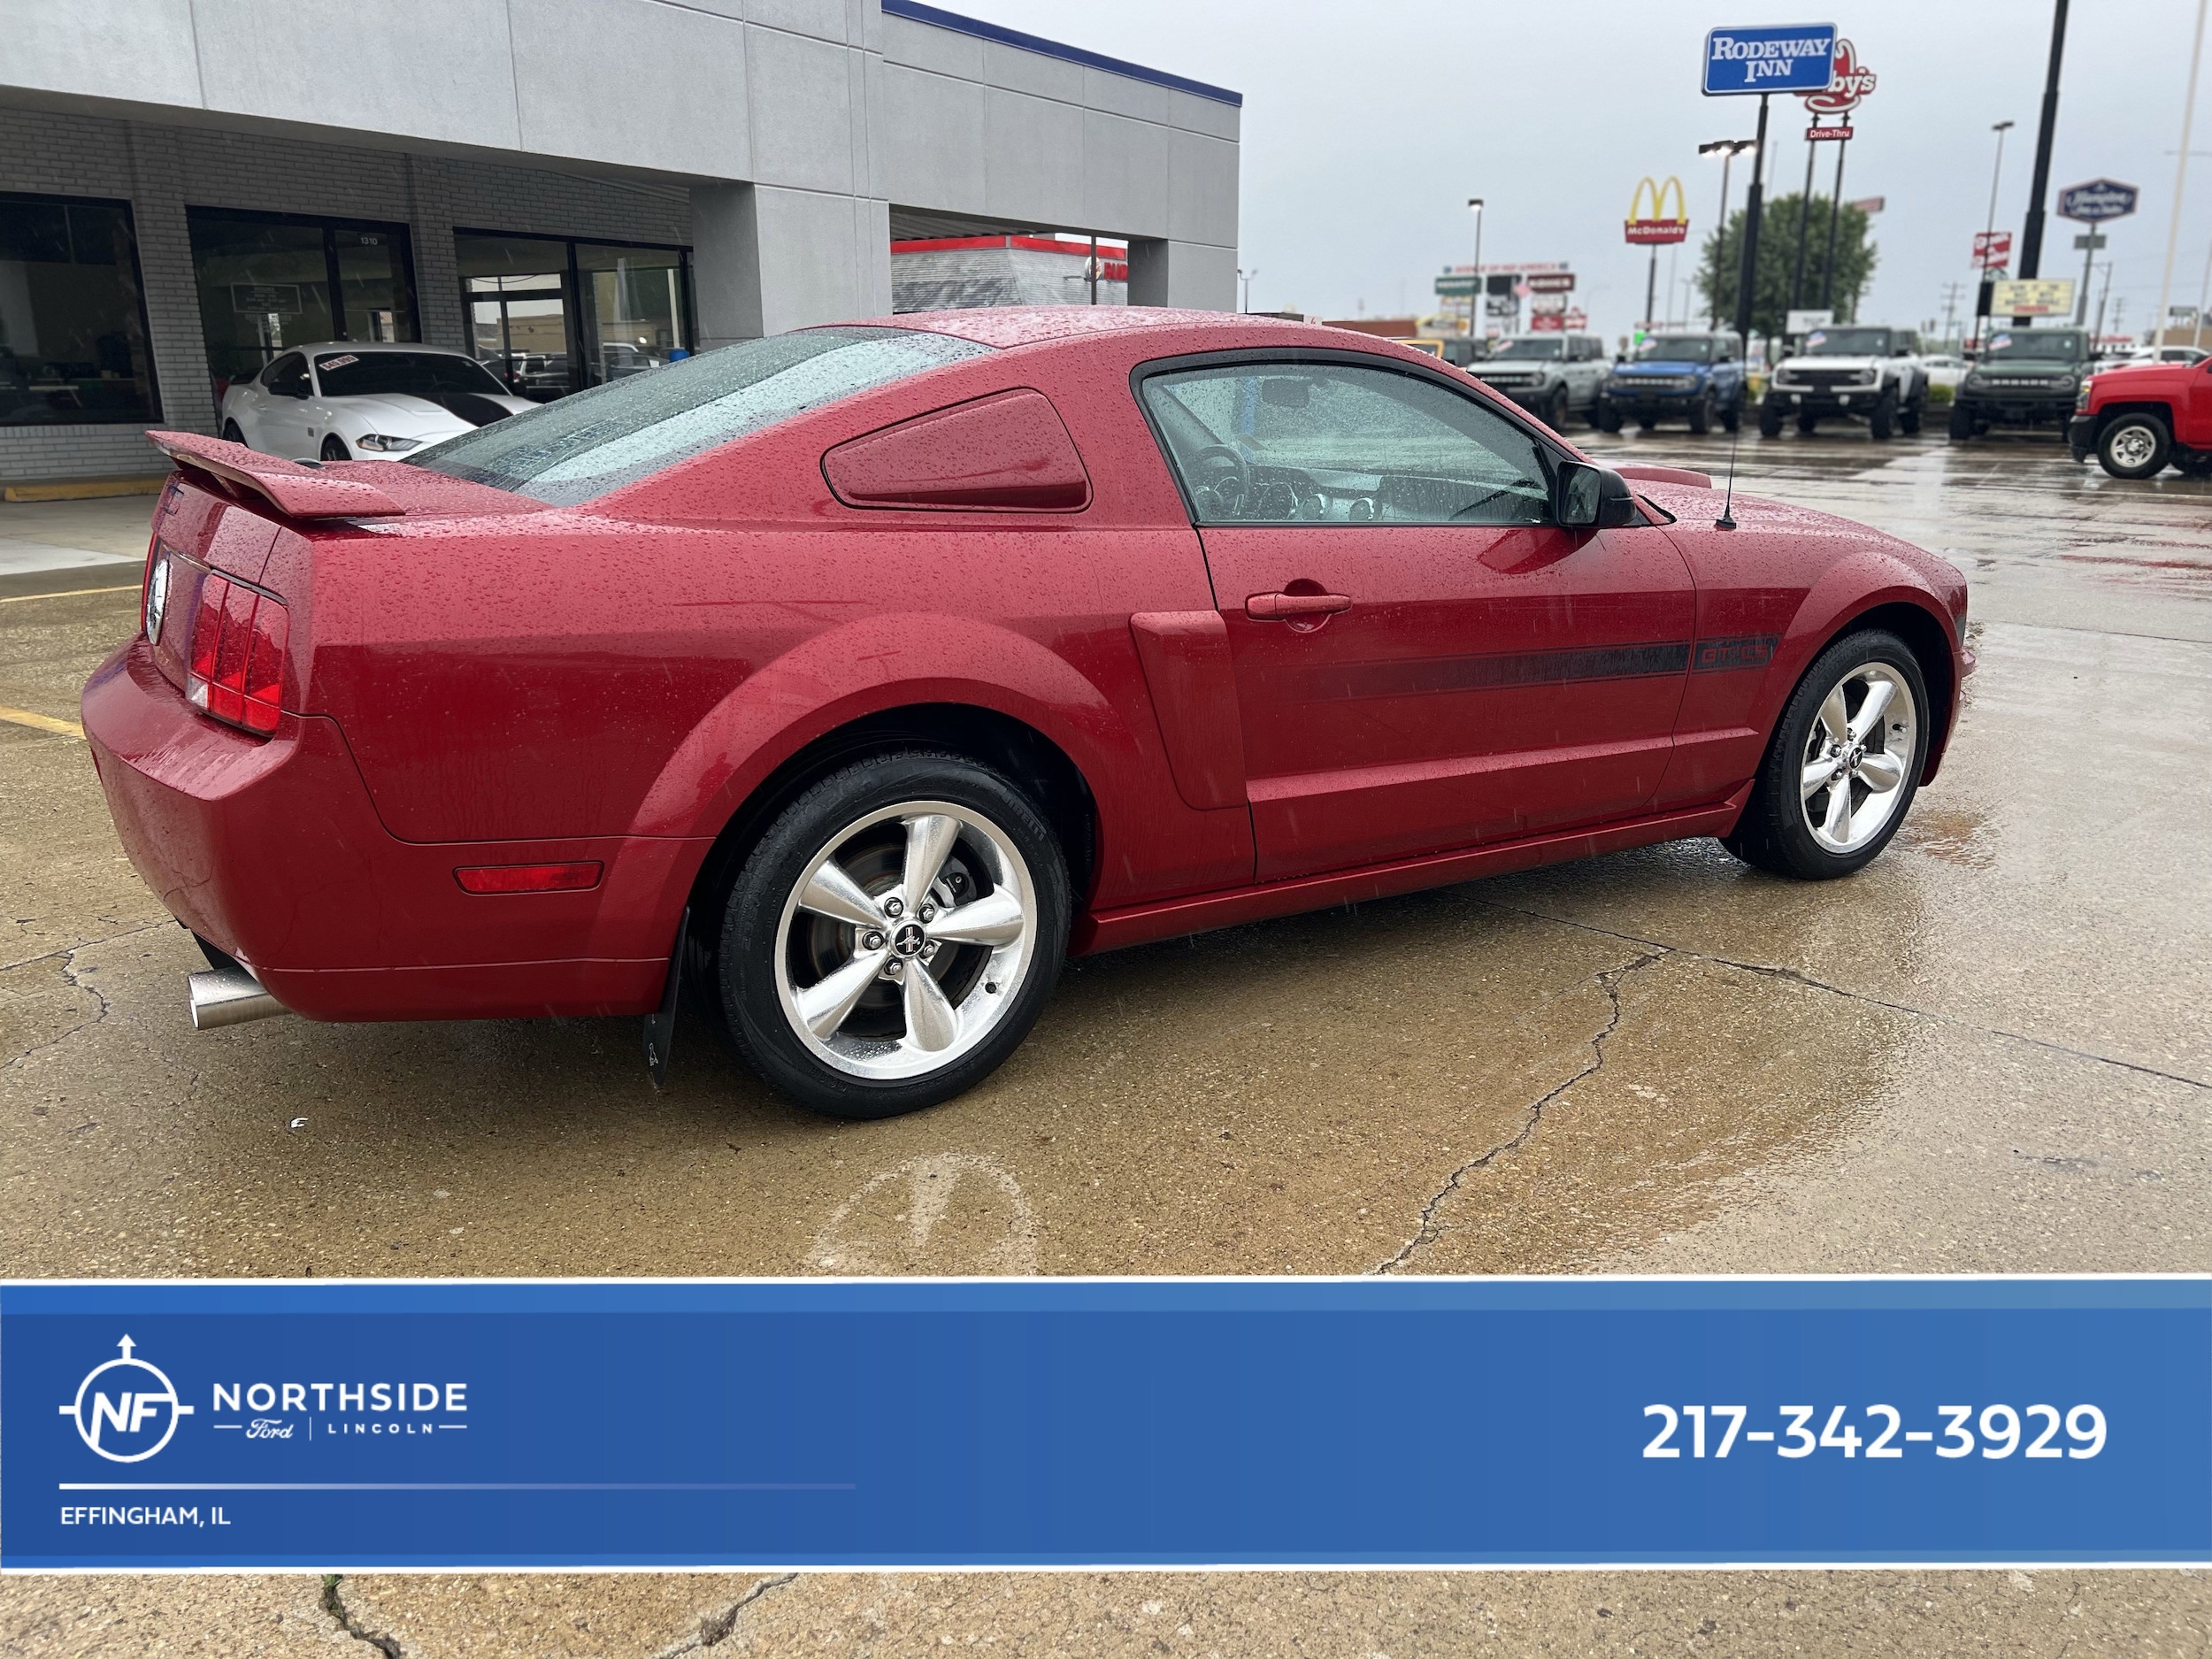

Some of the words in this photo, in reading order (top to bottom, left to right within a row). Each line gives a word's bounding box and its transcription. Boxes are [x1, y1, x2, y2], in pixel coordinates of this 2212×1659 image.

[1711, 37, 1832, 60] RODEWAY
[1744, 58, 1793, 82] INN
[1828, 67, 1876, 97] by's
[1810, 129, 1850, 138] Drive-Thru
[1627, 226, 1685, 235] McDonald's
[360, 236, 379, 246] 1310
